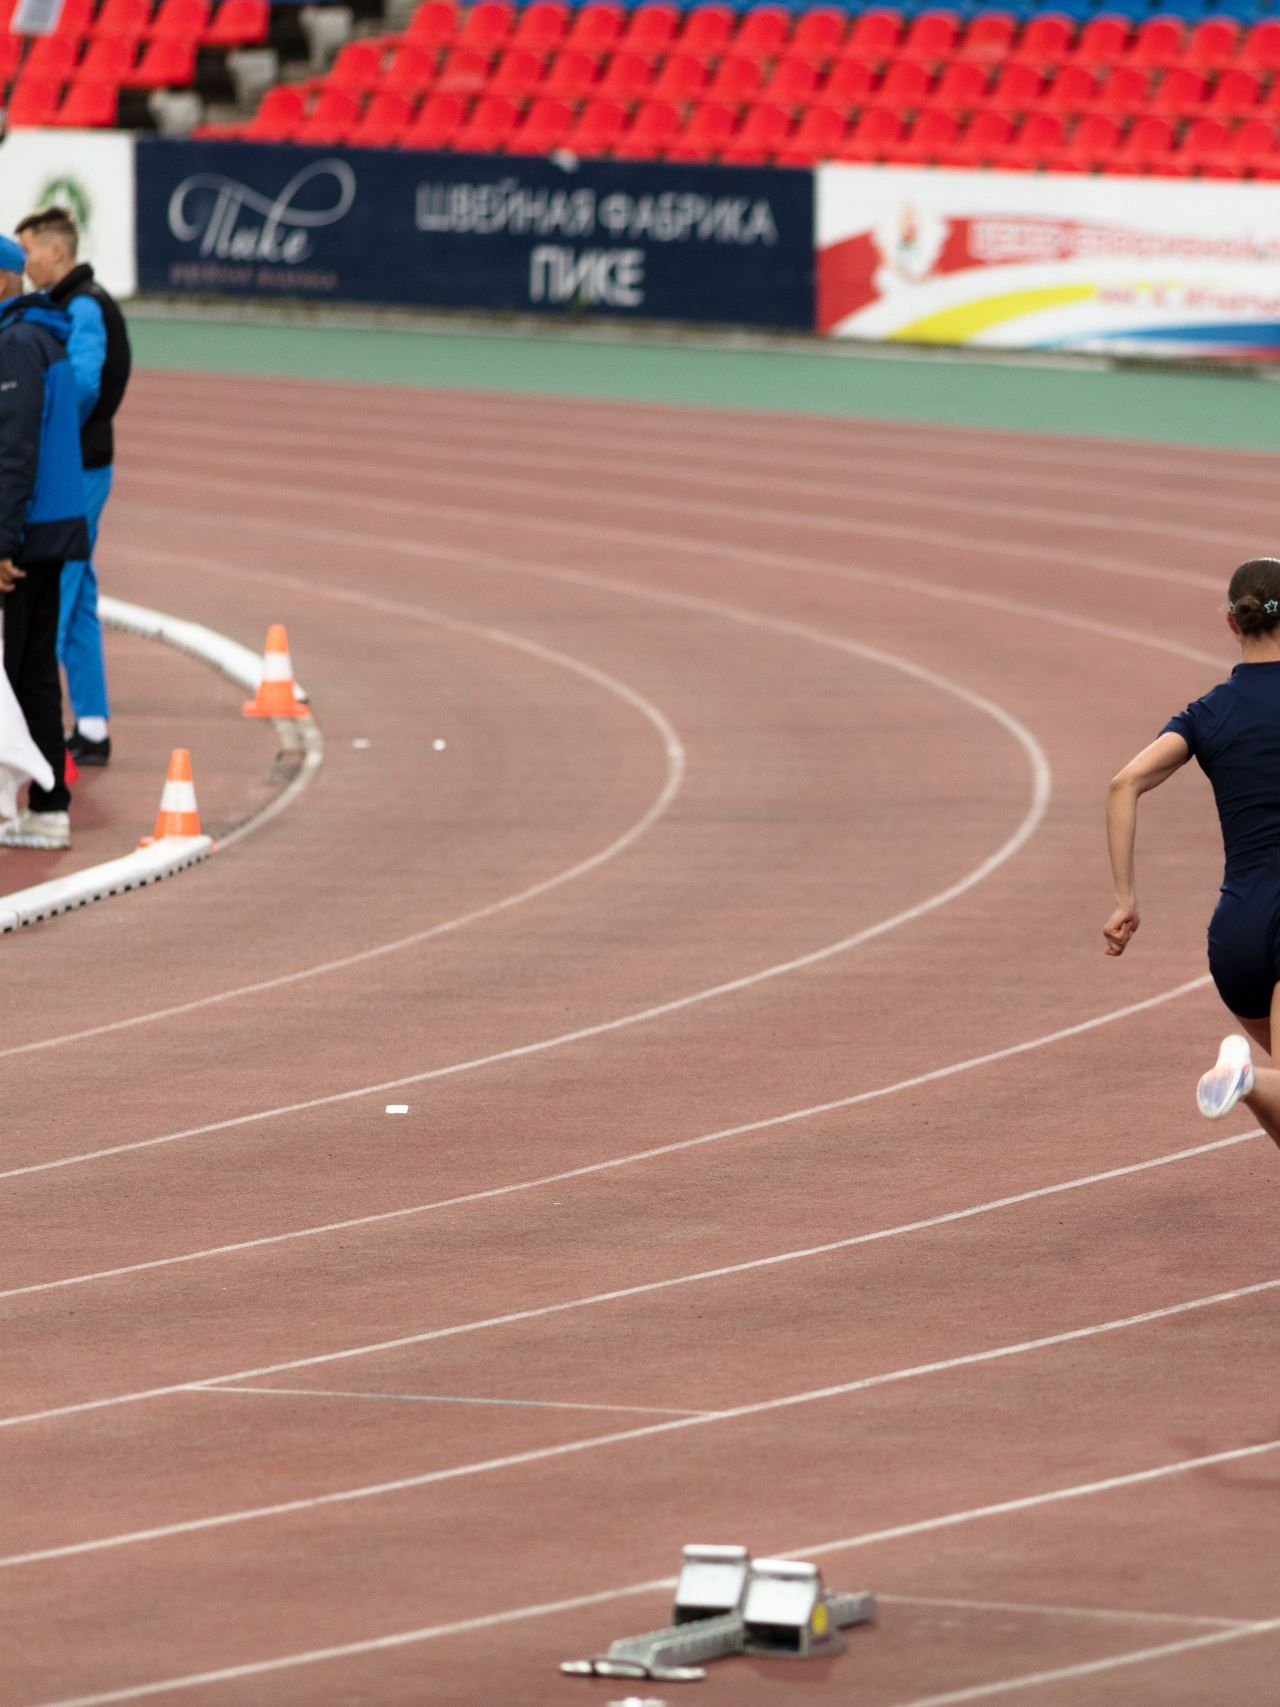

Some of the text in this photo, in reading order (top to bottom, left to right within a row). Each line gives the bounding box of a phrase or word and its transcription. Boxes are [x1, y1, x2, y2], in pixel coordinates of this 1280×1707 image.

[415, 177, 780, 247] ШВЕЙНАЯ ФАБРИКА
[530, 244, 645, 307] ПИКЕ
